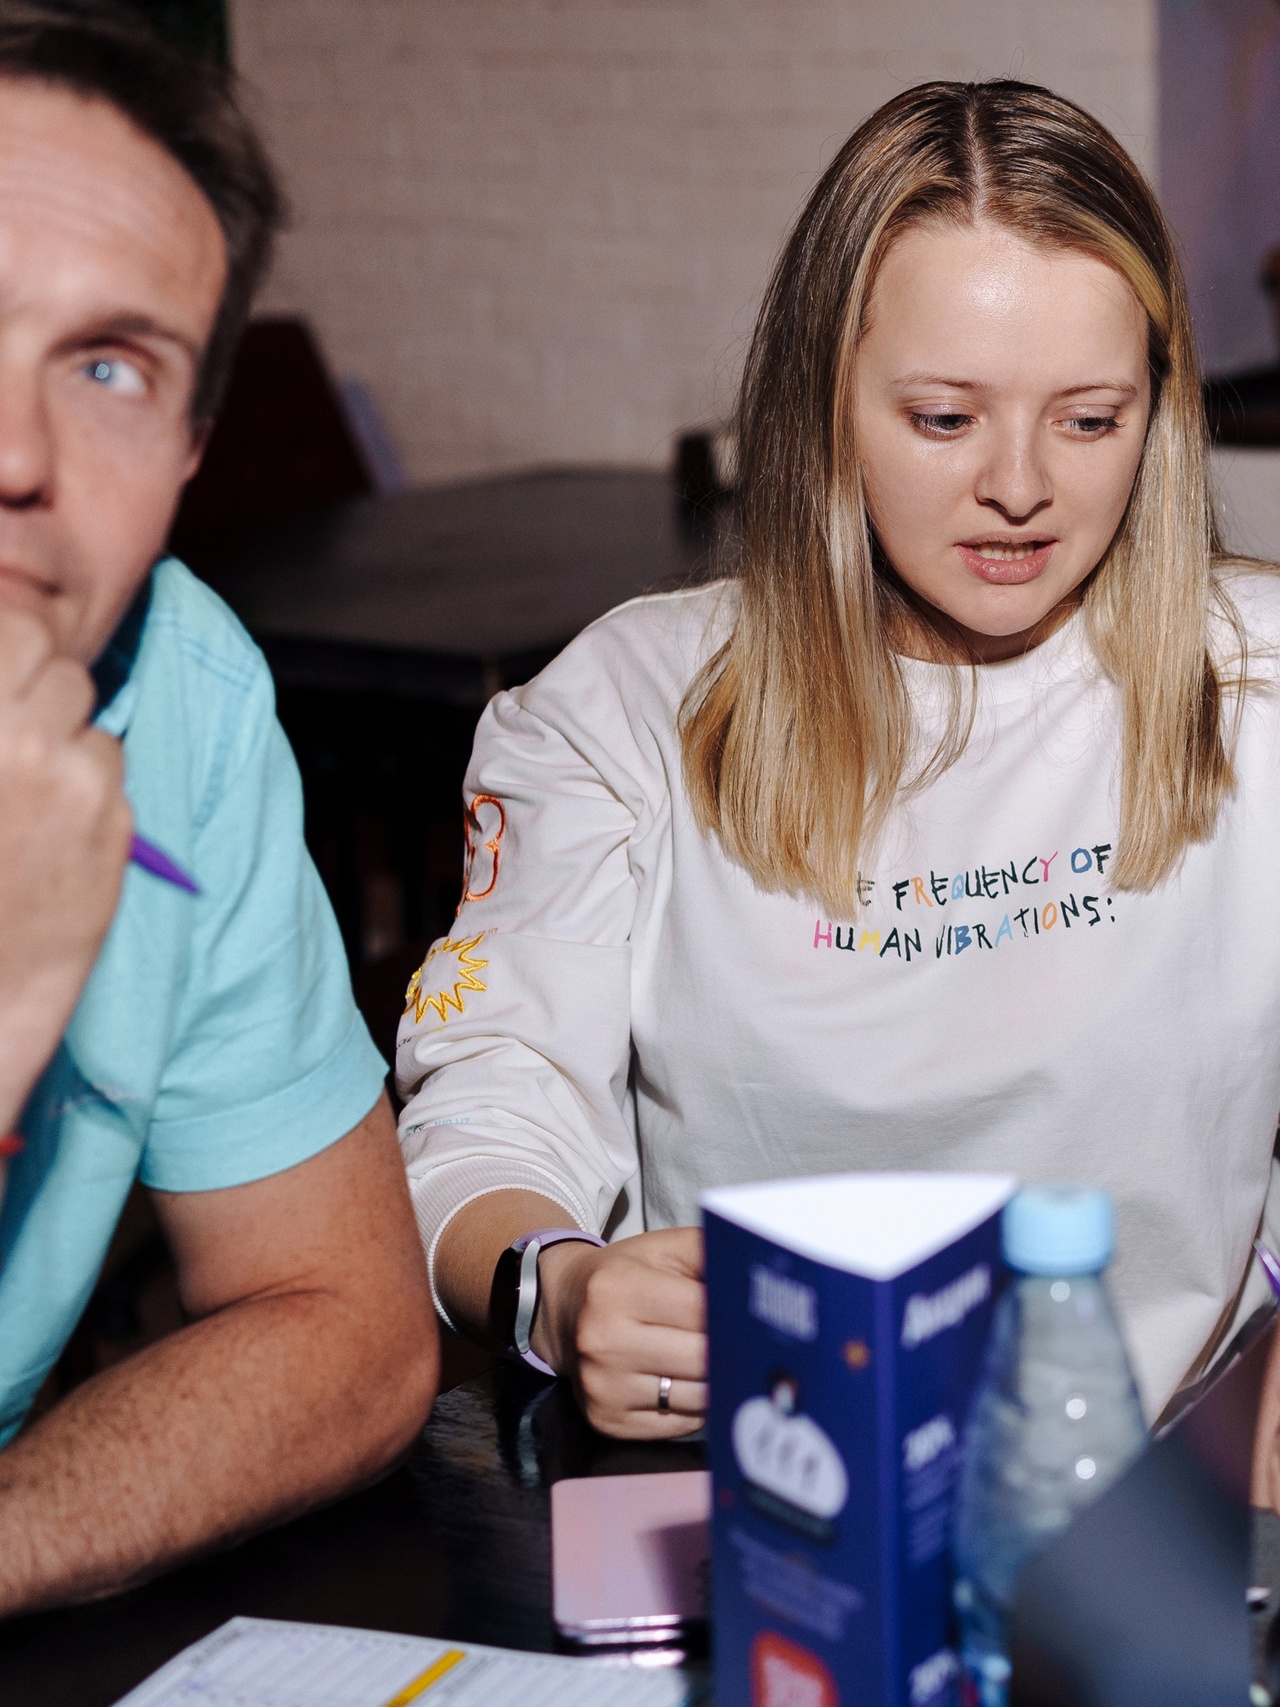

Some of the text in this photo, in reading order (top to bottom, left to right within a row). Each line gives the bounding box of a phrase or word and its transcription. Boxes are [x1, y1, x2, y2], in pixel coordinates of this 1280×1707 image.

[891, 851, 1059, 911] FREQUENCY
[1070, 843, 1112, 874] OF
[812, 893, 1116, 962] HUMAN VIBRATIONS:
